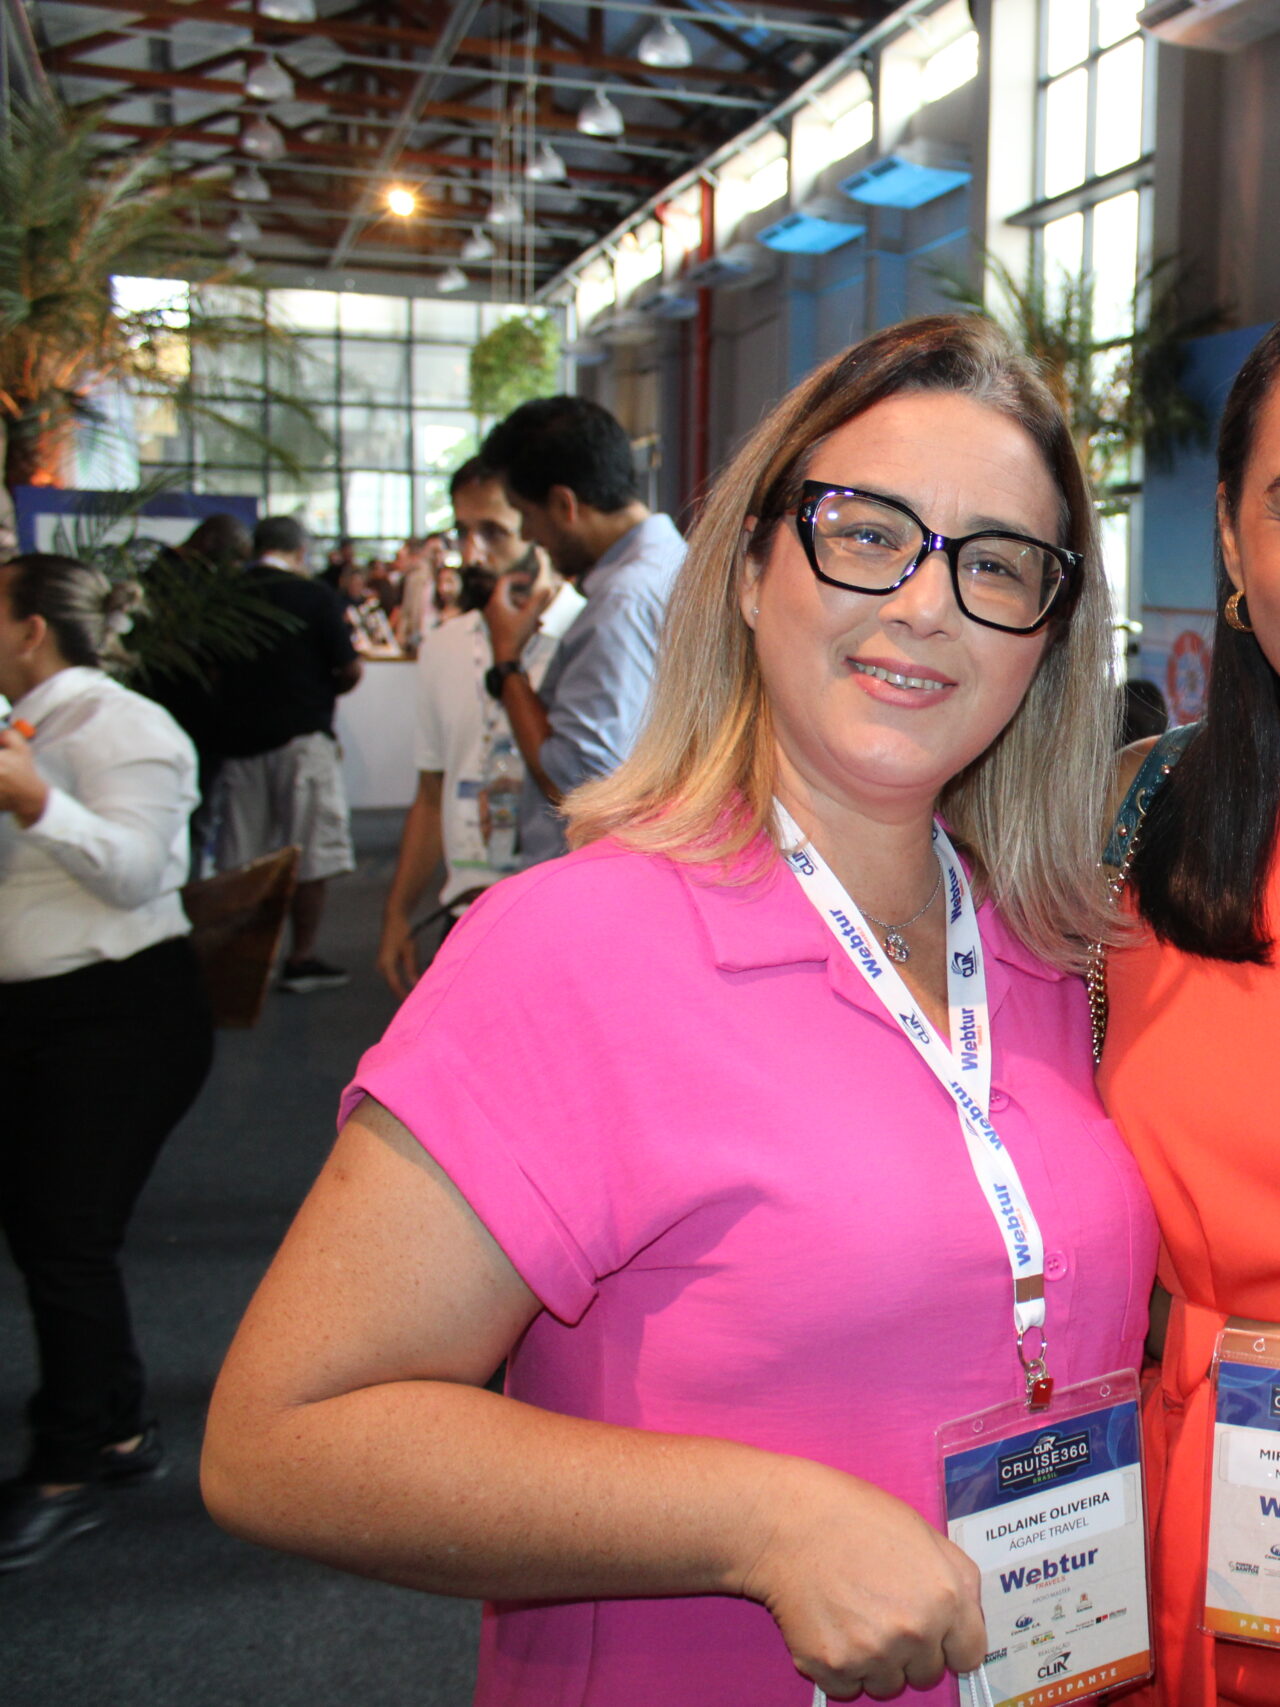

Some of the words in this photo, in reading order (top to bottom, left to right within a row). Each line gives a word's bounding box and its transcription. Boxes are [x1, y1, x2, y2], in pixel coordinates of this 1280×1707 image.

[829, 909, 883, 979] Webtur
[960, 1008, 978, 1071] Webtur
[949, 1079, 1003, 1151] Webtur
[993, 1183, 1031, 1267] Webtur
[1001, 1442, 1088, 1479] CRUISE360
[985, 1511, 1047, 1541] ILDLAINE
[1049, 1491, 1110, 1520] OLIVEIRA
[1049, 1516, 1089, 1538] TRAVEL
[1000, 1547, 1098, 1593] Webtur
[1035, 1575, 1066, 1590] TRAVELS
[1008, 1667, 1117, 1707] RTICIPANTE
